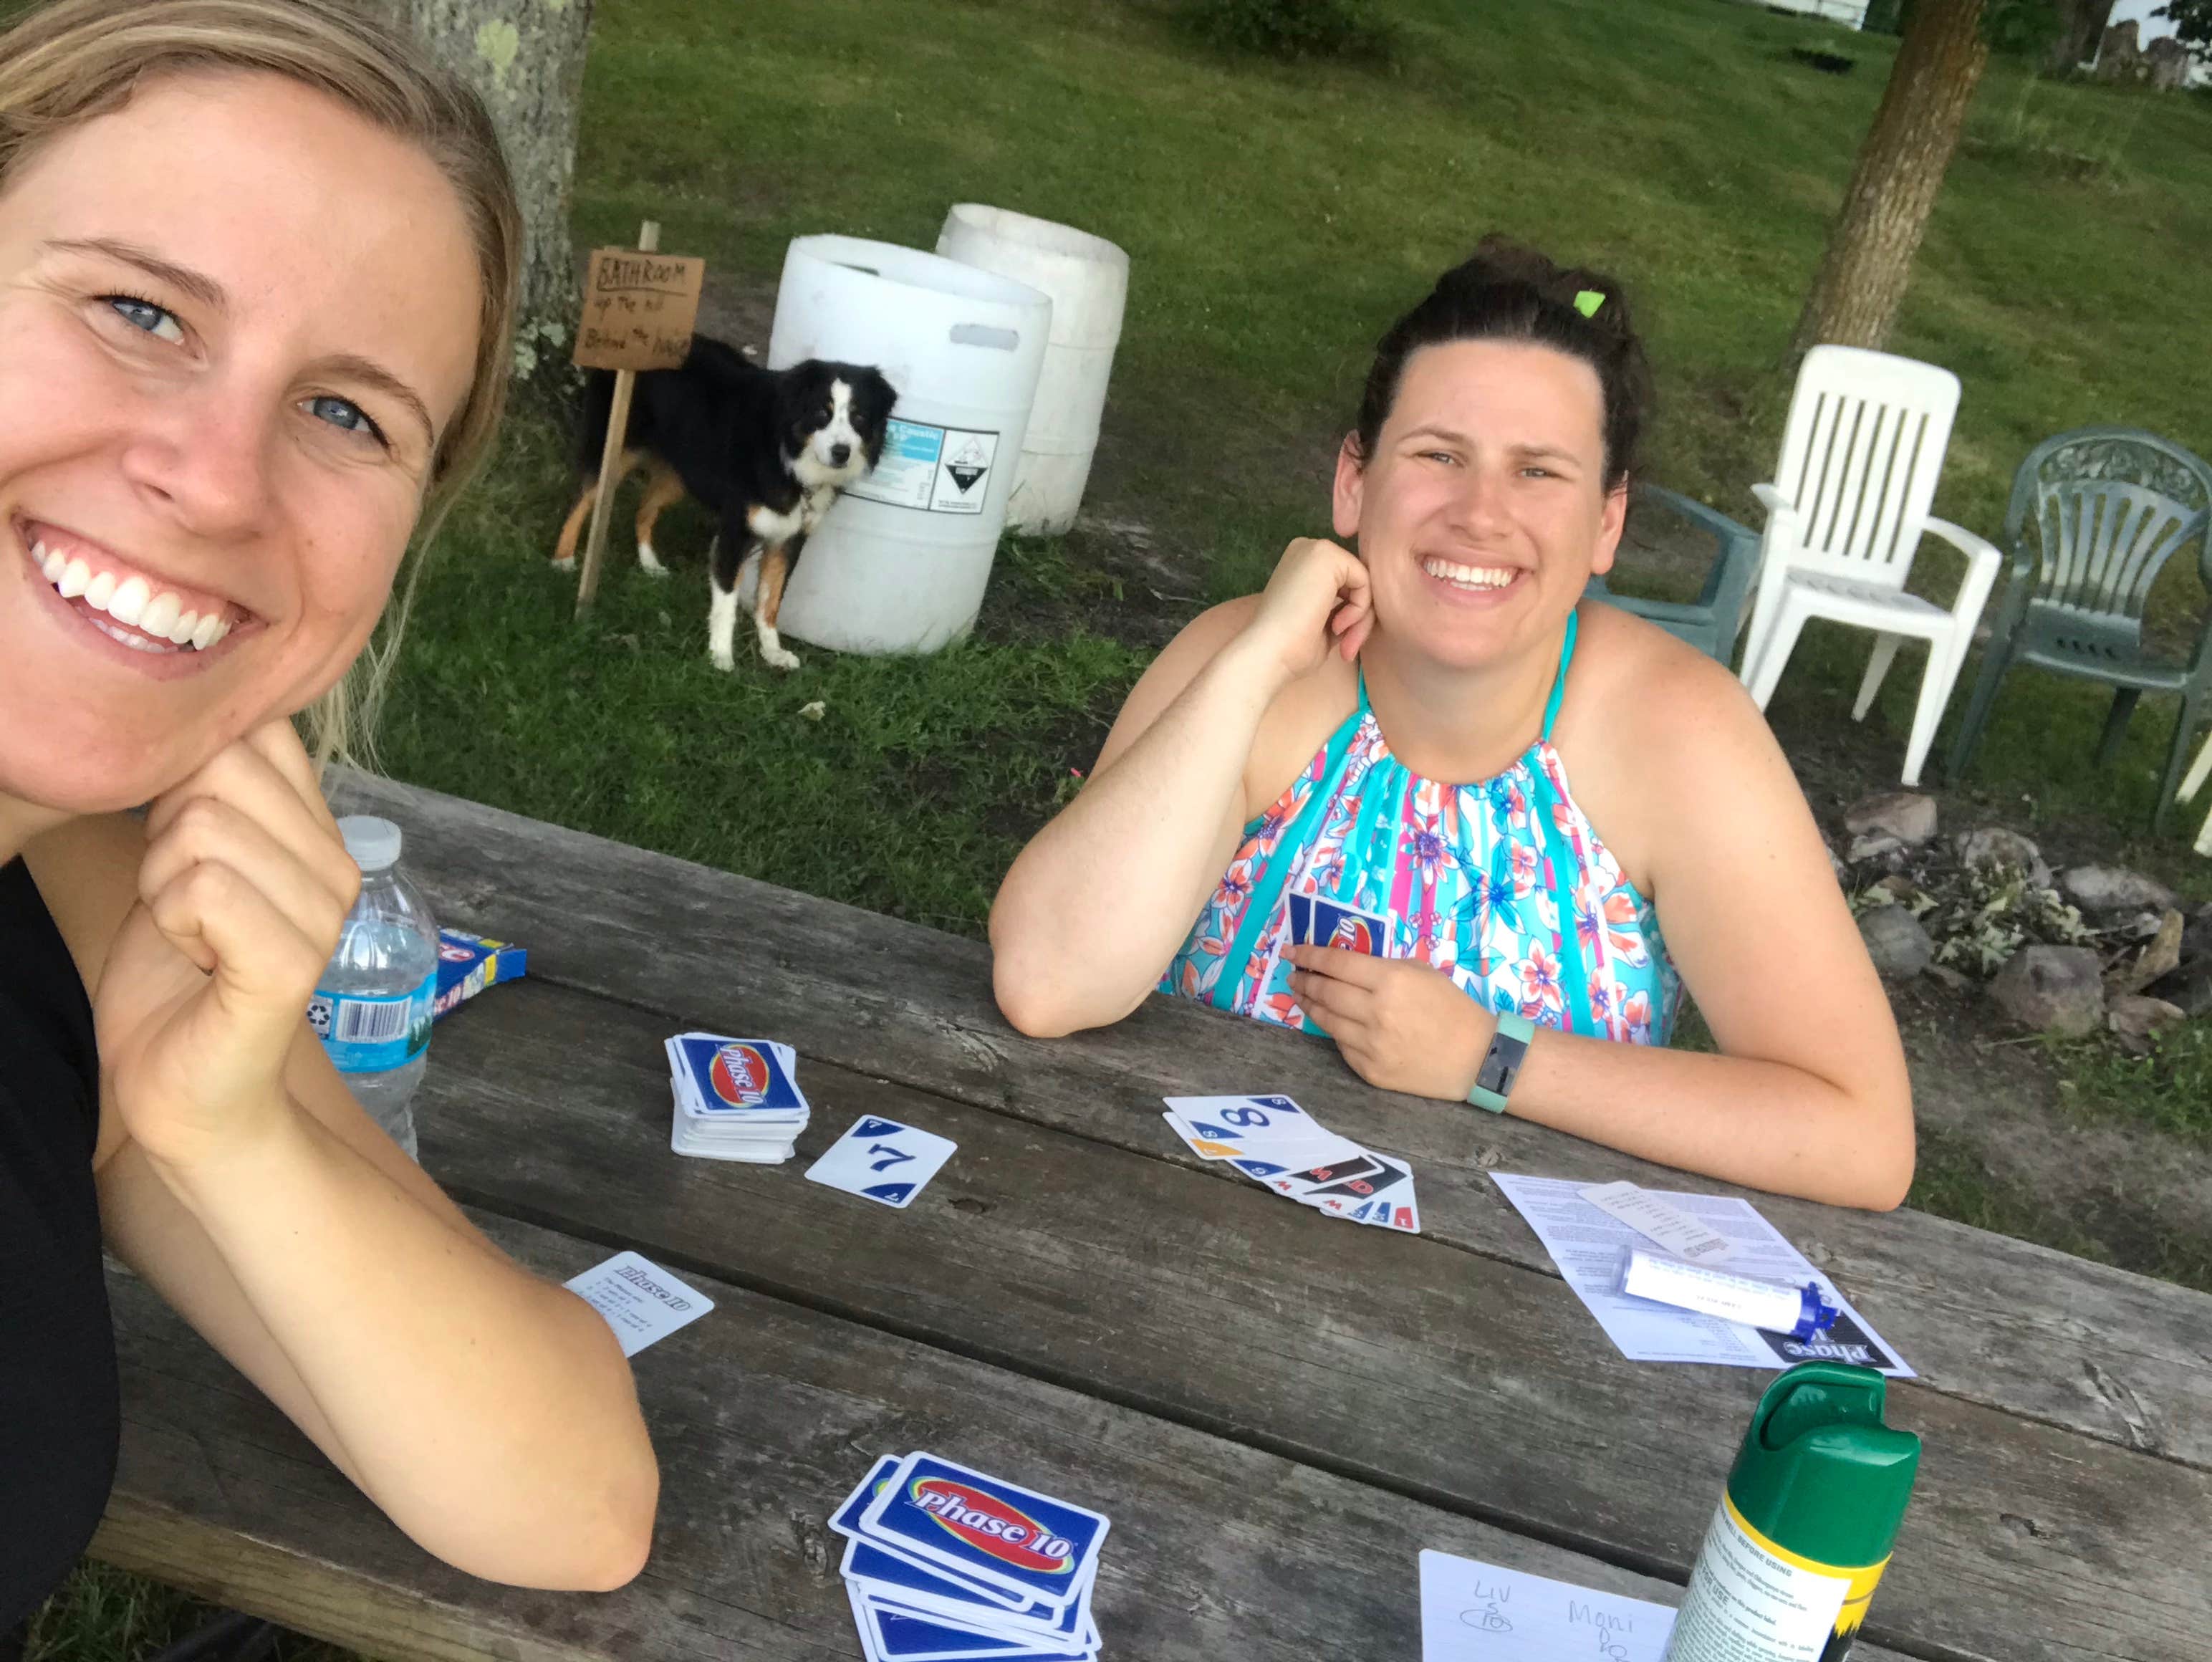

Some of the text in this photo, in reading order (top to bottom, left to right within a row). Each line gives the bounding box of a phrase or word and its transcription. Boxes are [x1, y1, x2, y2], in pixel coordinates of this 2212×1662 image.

[717, 1047, 765, 1104] Phase 10
[868, 1120, 882, 1129] 7
[1220, 1108, 1270, 1127] 8
[867, 1143, 917, 1172] 7
[884, 1192, 900, 1202] 7
[614, 1265, 670, 1300] Phase
[908, 1489, 1073, 1558] Phase 10
[1765, 1558, 1793, 1577] USING
[1712, 1584, 1729, 1605] USE
